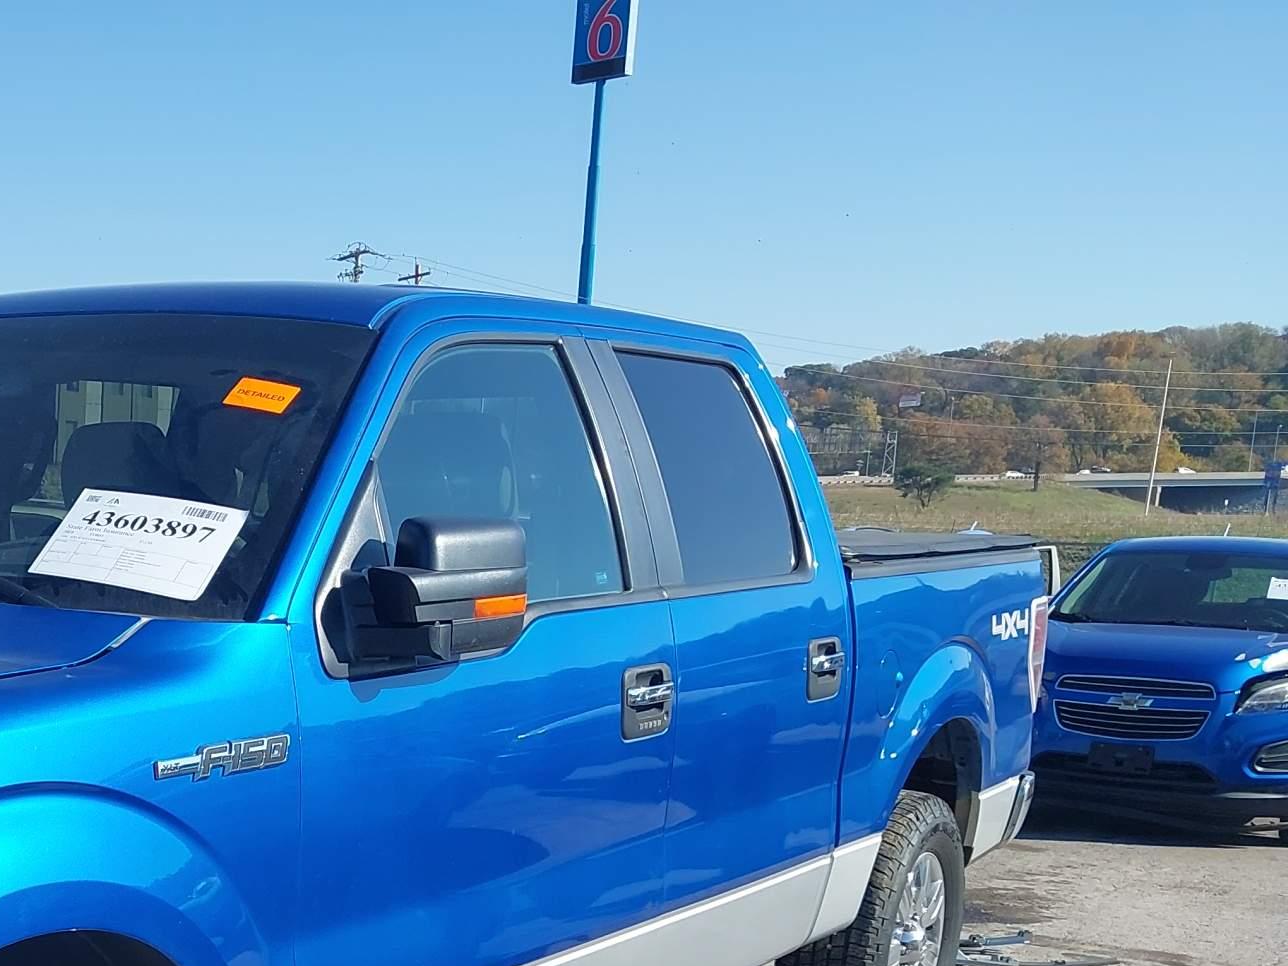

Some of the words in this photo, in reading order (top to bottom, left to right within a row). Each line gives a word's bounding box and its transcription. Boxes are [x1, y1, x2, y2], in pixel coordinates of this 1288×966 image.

[587, 0, 623, 61] 6
[237, 388, 285, 402] DETAILED
[82, 510, 217, 543] 43603897
[196, 734, 290, 781] F-150
